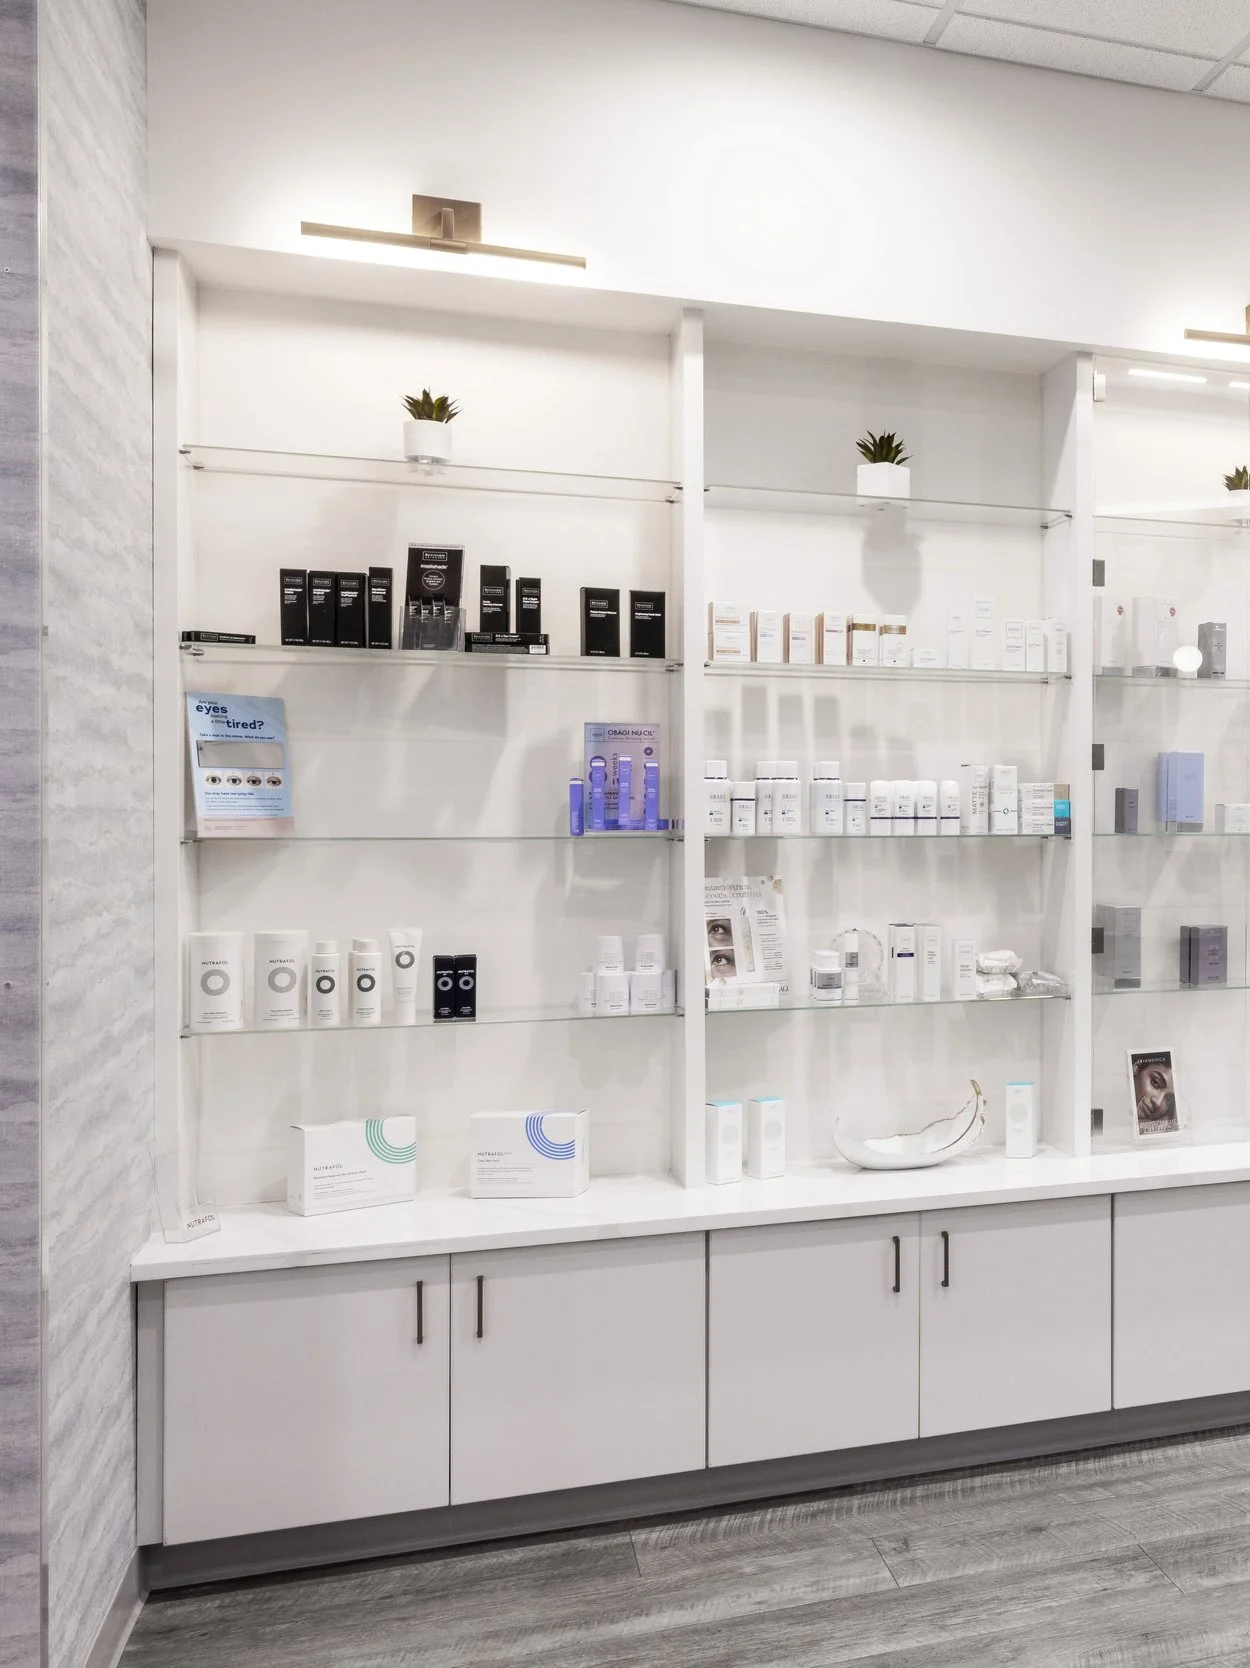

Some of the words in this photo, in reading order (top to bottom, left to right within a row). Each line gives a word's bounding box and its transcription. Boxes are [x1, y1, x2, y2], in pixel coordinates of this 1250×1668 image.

[196, 705, 228, 714] eyes
[226, 718, 264, 730] tired?
[186, 1213, 216, 1230] NUTRAFOL
